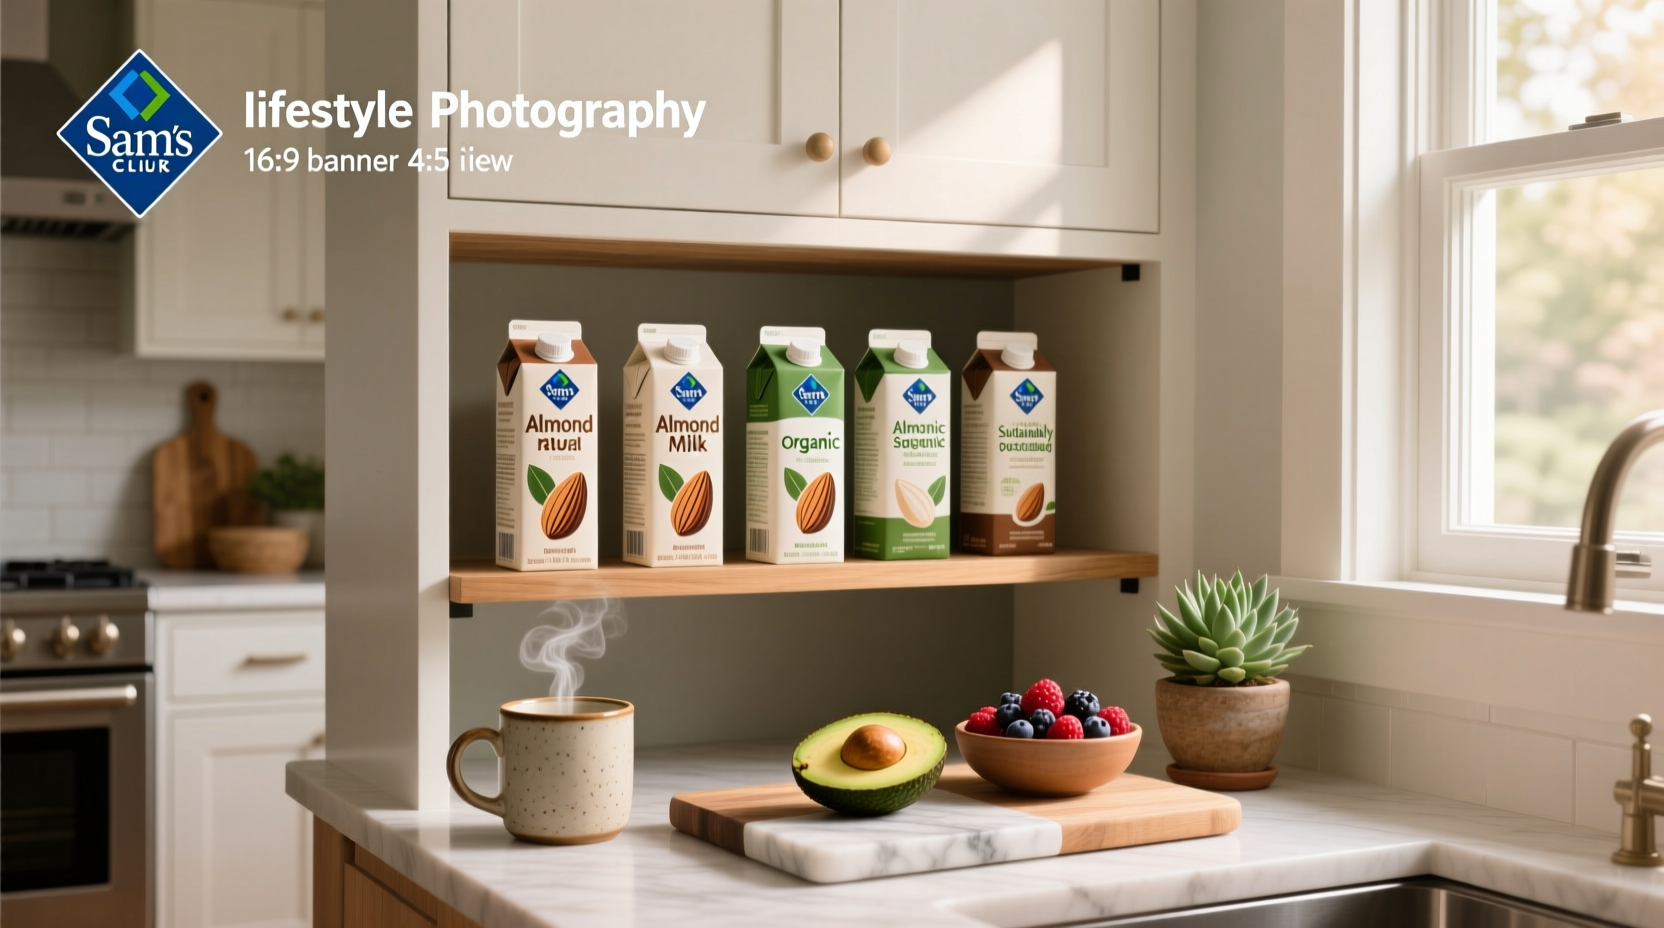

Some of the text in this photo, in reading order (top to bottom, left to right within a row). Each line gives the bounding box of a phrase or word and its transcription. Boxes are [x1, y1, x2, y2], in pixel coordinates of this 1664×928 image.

[525, 414, 593, 433] Almond
[655, 414, 720, 433] Almond
[669, 434, 708, 452] Milk
[781, 431, 841, 454] Organic
